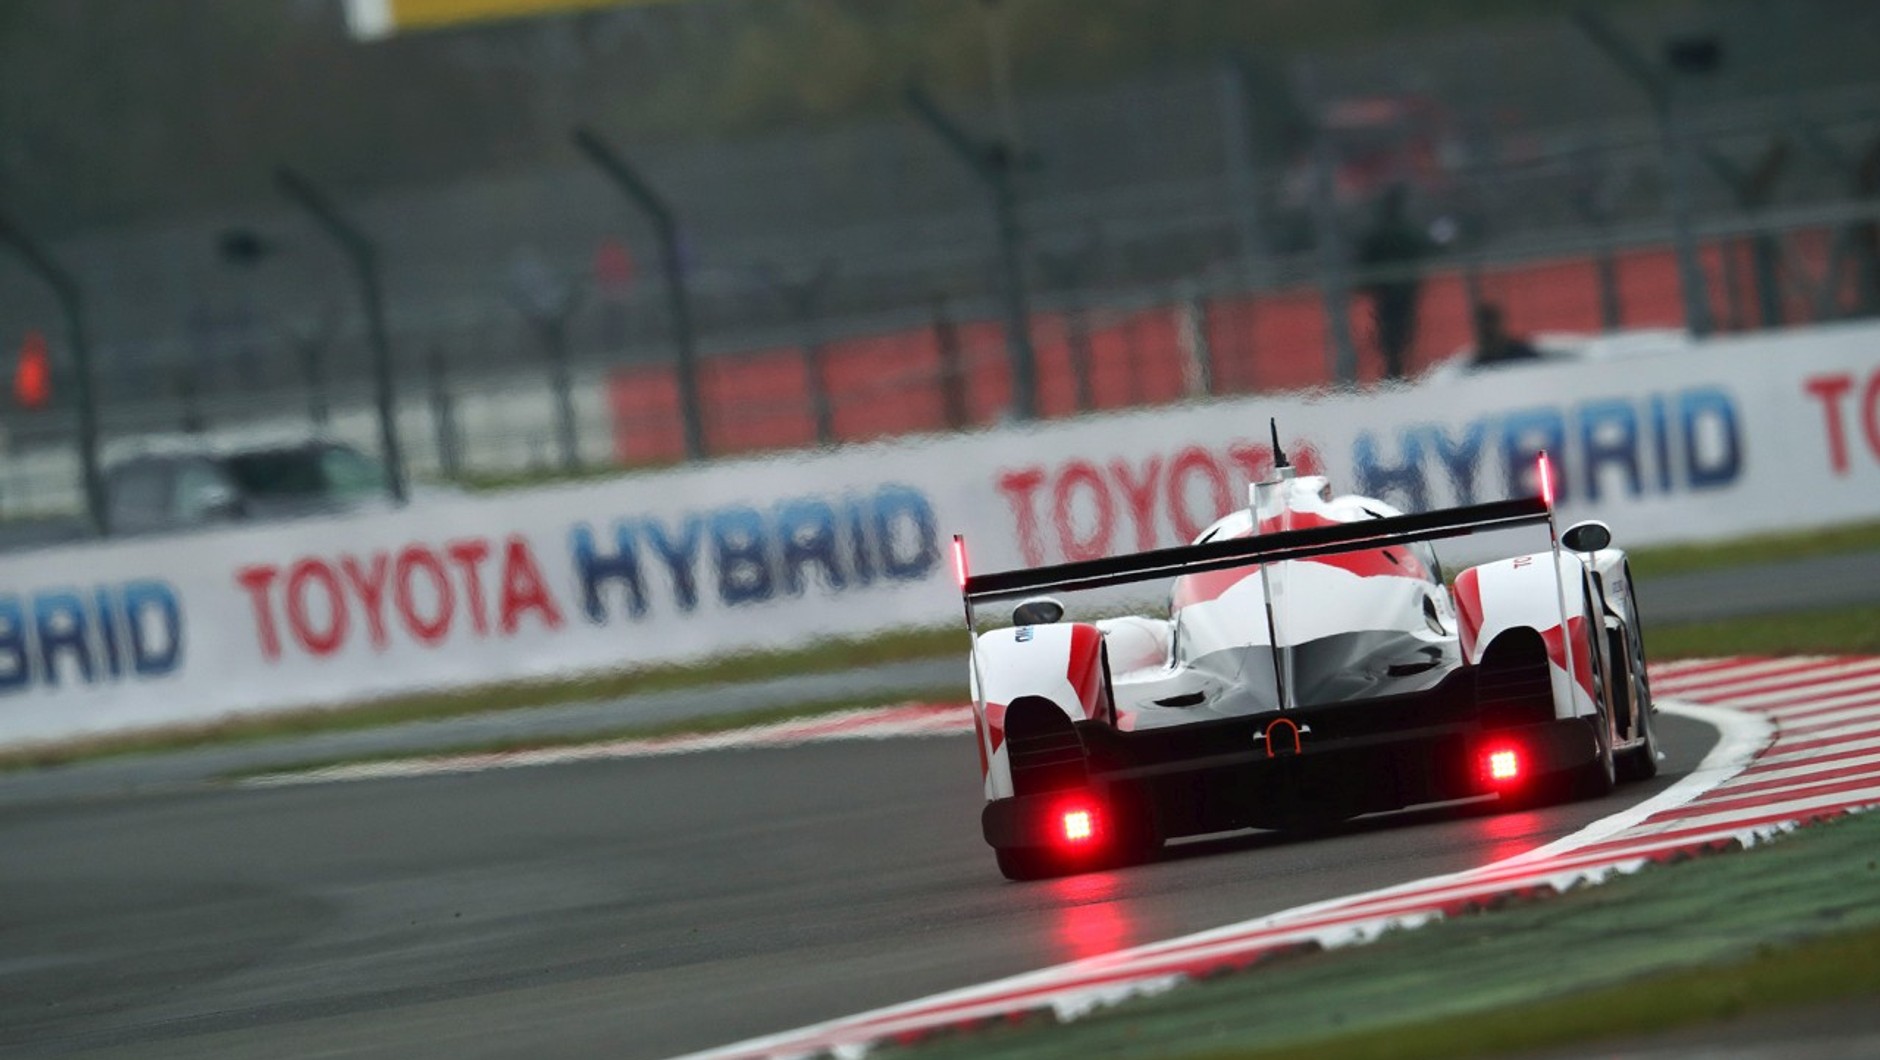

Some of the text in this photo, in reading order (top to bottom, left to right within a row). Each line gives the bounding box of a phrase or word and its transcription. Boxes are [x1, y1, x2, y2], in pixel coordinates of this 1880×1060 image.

[235, 534, 563, 661] TOYOTA
[570, 483, 938, 624] HYBRID
[1353, 385, 1744, 512] HYBRID
